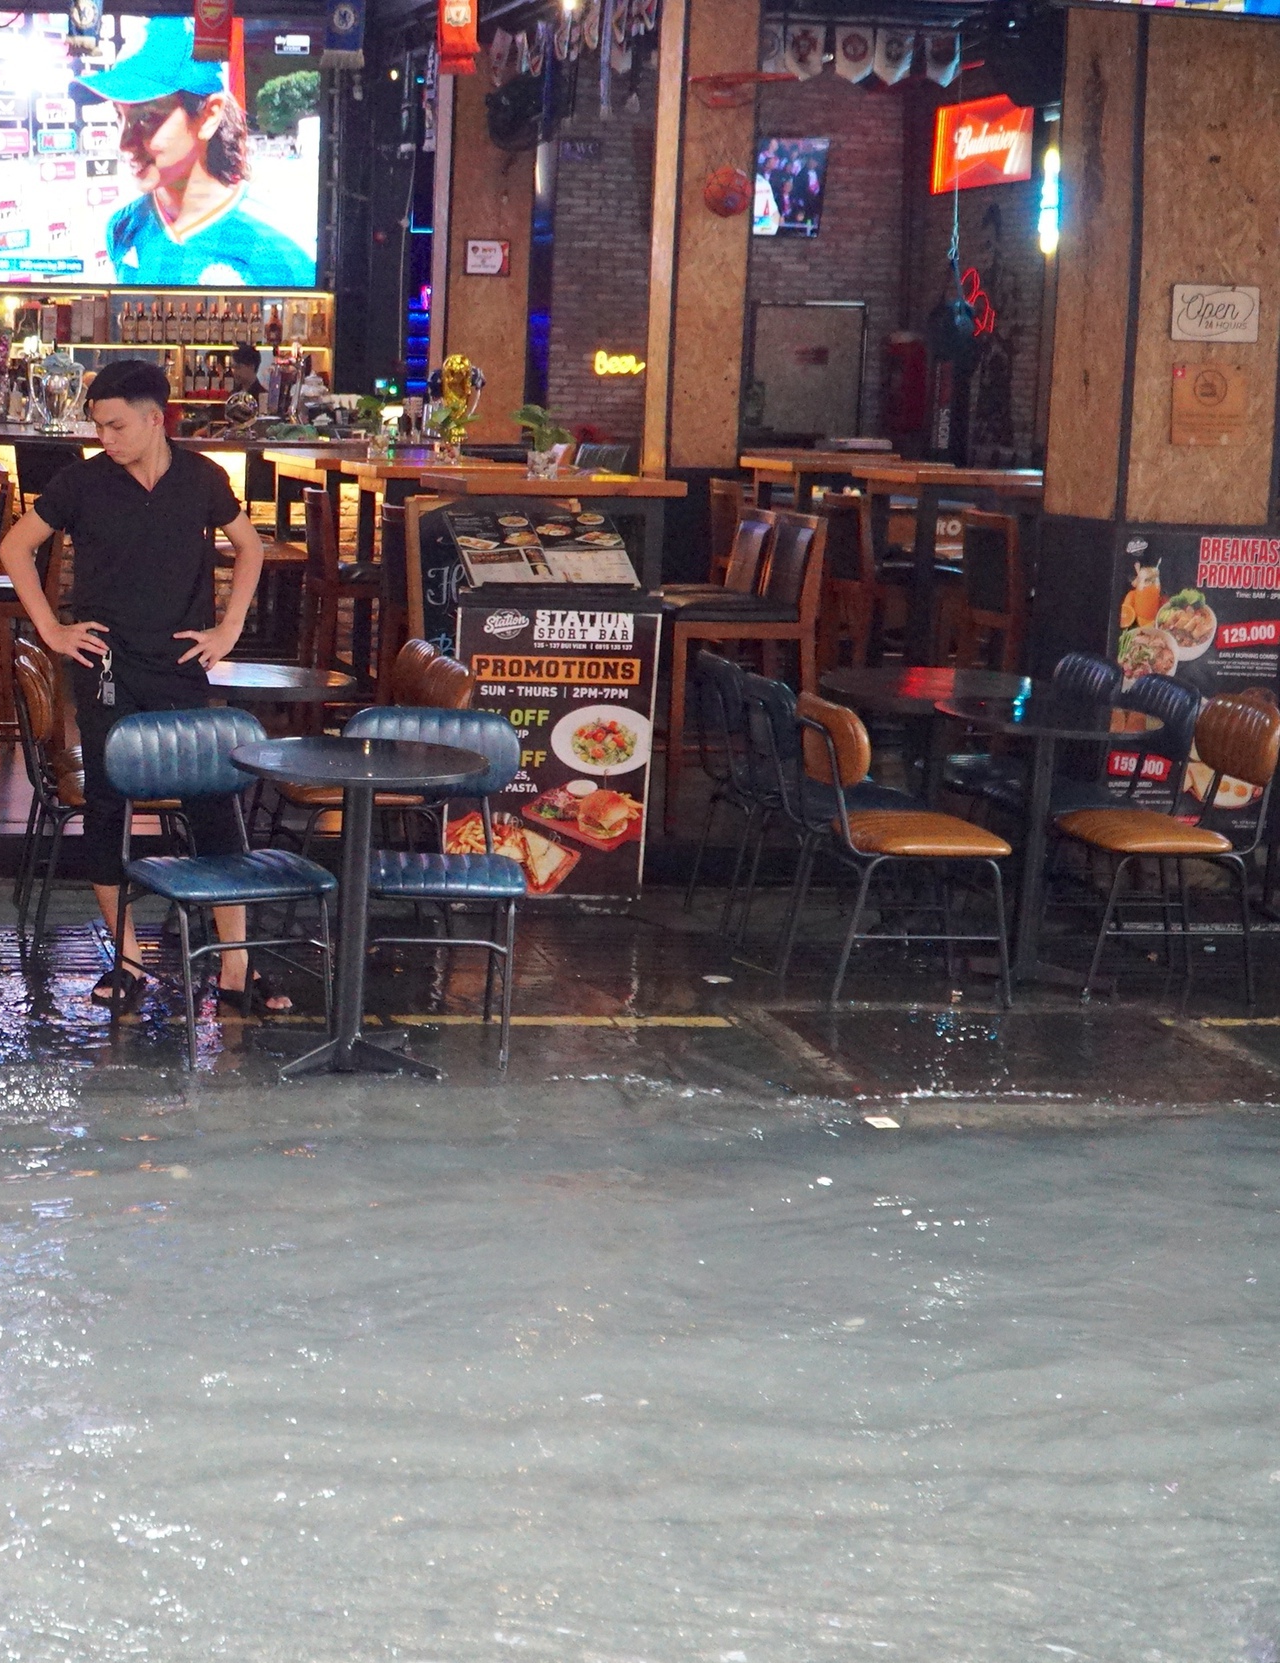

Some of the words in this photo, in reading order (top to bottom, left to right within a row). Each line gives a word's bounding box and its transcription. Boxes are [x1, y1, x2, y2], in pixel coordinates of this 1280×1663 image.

[954, 122, 1024, 175] Budweiser
[1181, 292, 1239, 327] Open
[1204, 320, 1214, 330] 24
[1215, 321, 1248, 331] HOURS
[1200, 536, 1280, 565] BREAKFAS
[484, 611, 530, 635] Station
[535, 609, 634, 629] STATION
[537, 628, 588, 640] SPORT
[598, 629, 629, 641] BAR
[1222, 624, 1276, 644] 129.000
[475, 657, 635, 681] PROMOTIONS
[480, 685, 506, 696] SUN
[517, 686, 558, 698] THURS
[572, 687, 629, 699] 2PM-7PM
[509, 708, 550, 727] OFF
[521, 750, 547, 768] FF
[514, 771, 531, 782] ES,
[505, 783, 538, 793] PASTA
